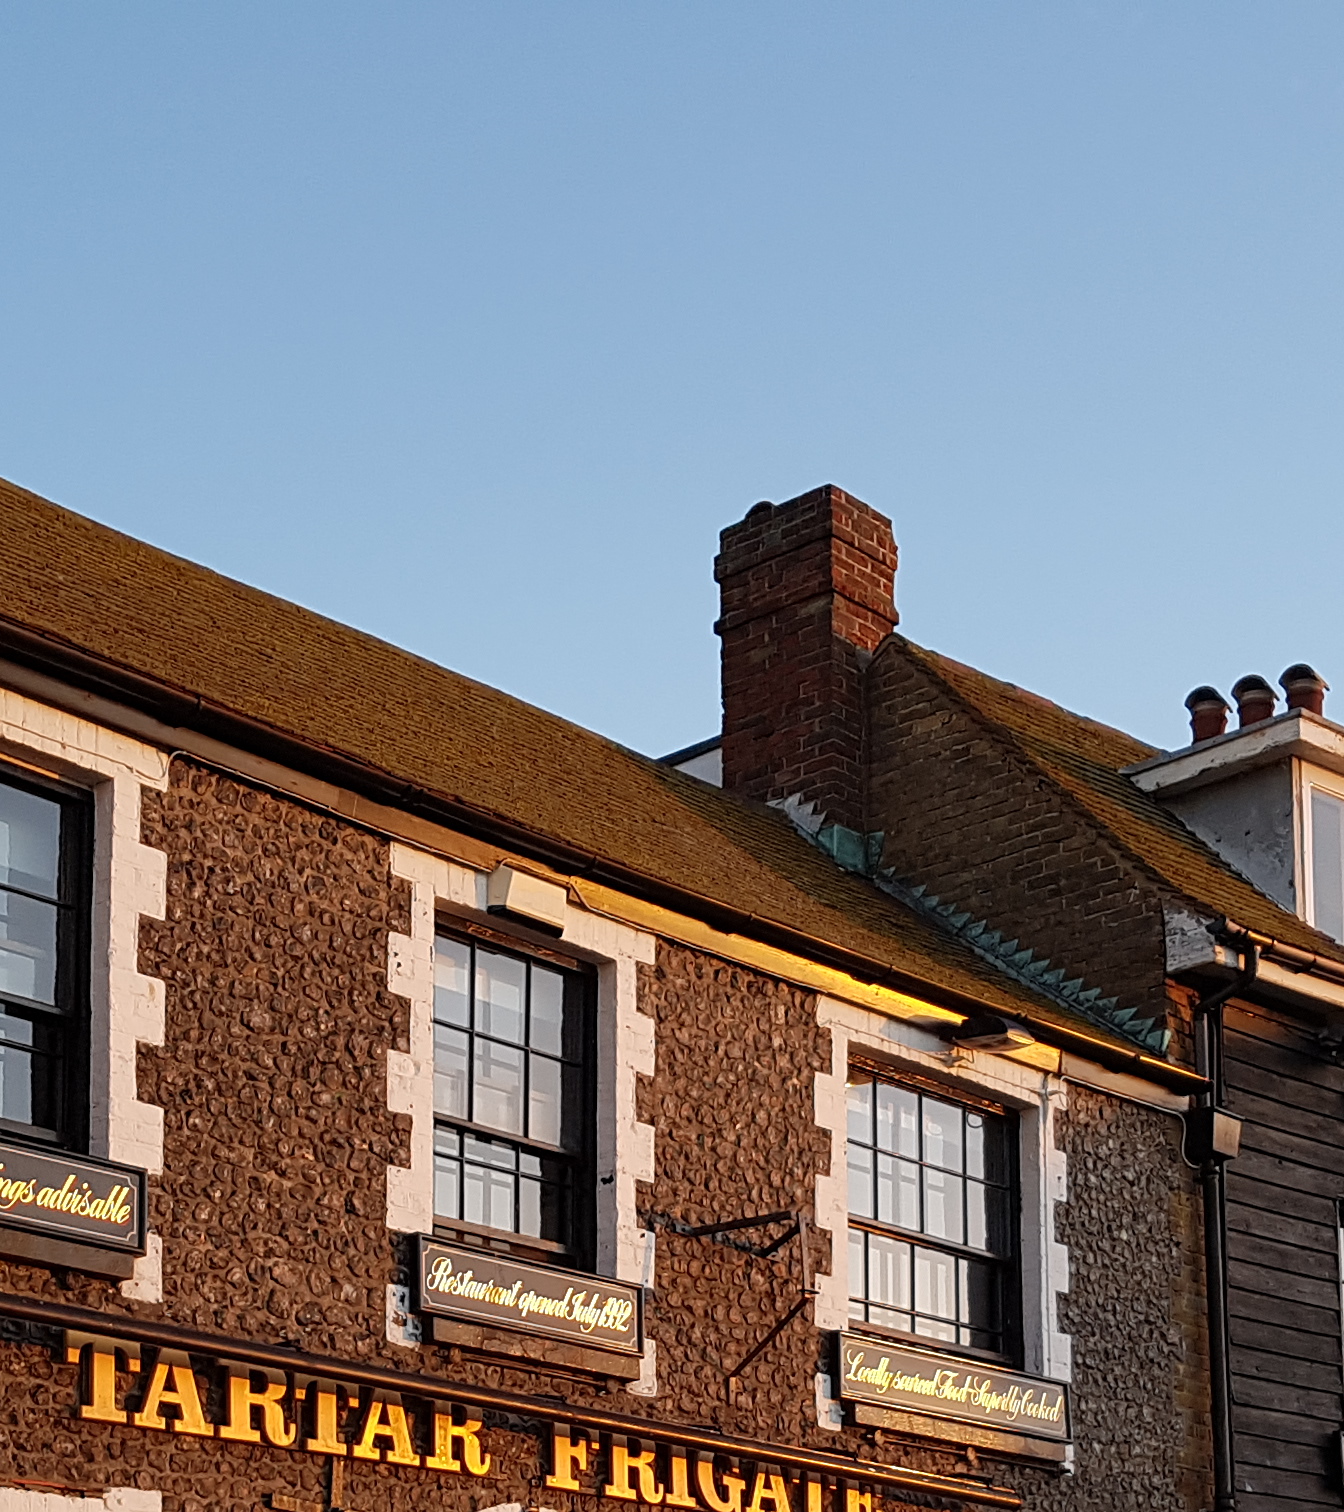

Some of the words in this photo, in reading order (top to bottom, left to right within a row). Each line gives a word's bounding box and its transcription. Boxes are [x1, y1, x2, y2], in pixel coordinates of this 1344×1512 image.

[36, 1174, 132, 1224] advisable
[427, 1256, 523, 1307] Restaurant
[518, 1280, 573, 1317] opened
[565, 1290, 601, 1333] July
[597, 1296, 633, 1332] 1992
[65, 1330, 490, 1478] TARTAR
[845, 1348, 892, 1394] Locally
[936, 1370, 972, 1402] Food
[1019, 1386, 1063, 1423] Cooked
